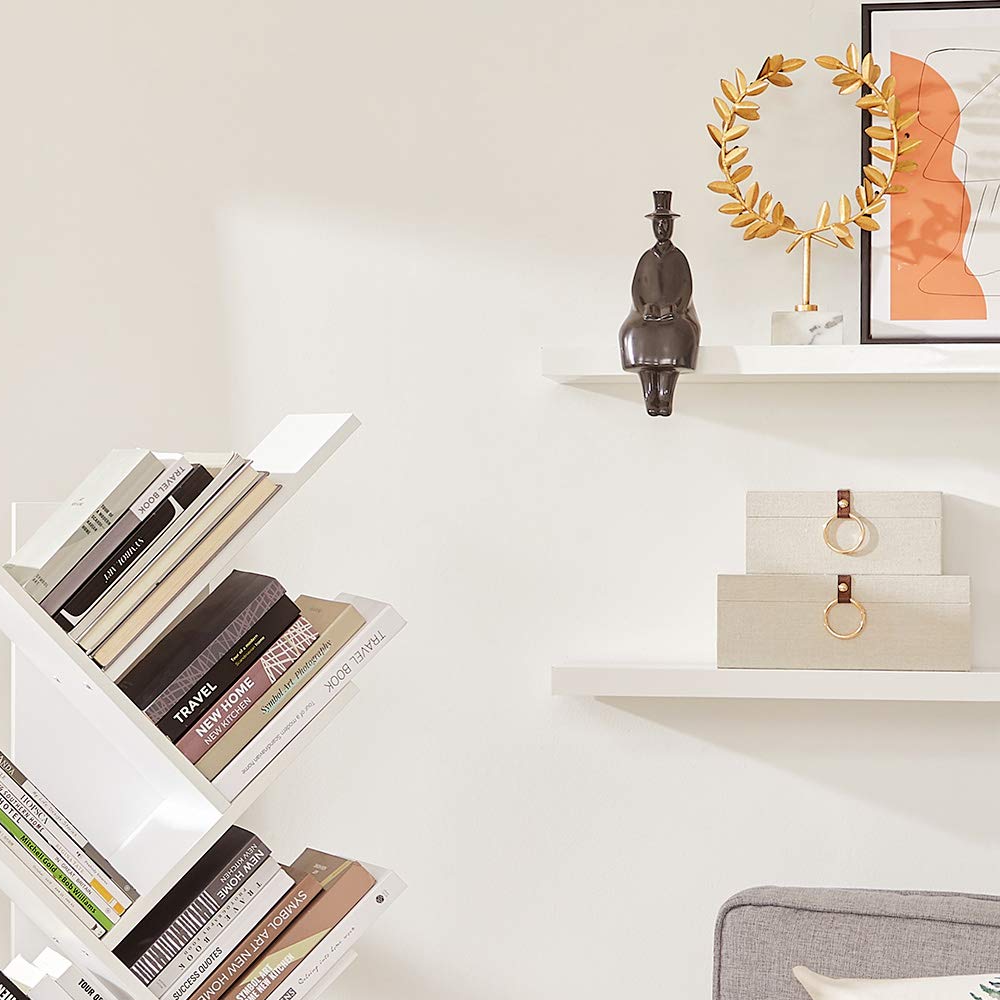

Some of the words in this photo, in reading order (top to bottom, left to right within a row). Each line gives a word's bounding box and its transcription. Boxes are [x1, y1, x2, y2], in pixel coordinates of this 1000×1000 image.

[158, 466, 186, 492] TRAVEL
[138, 492, 160, 514] BOOK
[116, 539, 144, 565] SYMBOL
[102, 565, 117, 581] ART
[349, 630, 386, 664] TRAVEL
[260, 688, 284, 715] Symbol
[281, 677, 295, 693] Art
[294, 640, 332, 679] Photography
[324, 663, 352, 693] BOOK
[173, 683, 217, 722] TRAVEL
[194, 709, 224, 737] NEW
[219, 676, 255, 710] HOME
[203, 725, 224, 745] NEW
[221, 697, 252, 728] KITCHEN
[1, 791, 32, 818] SOUTHERN
[27, 817, 44, 834] HOME
[18, 794, 51, 825] HOPSCA
[243, 843, 258, 860] NEW
[243, 849, 265, 873] NEW
[19, 835, 46, 860] Mitchell
[41, 857, 59, 873] Gold
[72, 888, 99, 914] Williams
[220, 857, 245, 883] KITCHEN
[217, 871, 245, 900] HOME
[213, 882, 265, 928] TRAVEL
[267, 890, 307, 929] SYMBOL
[178, 936, 210, 970] BOOK
[248, 928, 271, 952] ART
[173, 971, 200, 1000] SUCCESS
[198, 947, 223, 973] QUOTES
[227, 949, 252, 976] NEW
[256, 964, 274, 981] ART
[78, 978, 95, 996] TOUR
[255, 976, 273, 994] NEW
